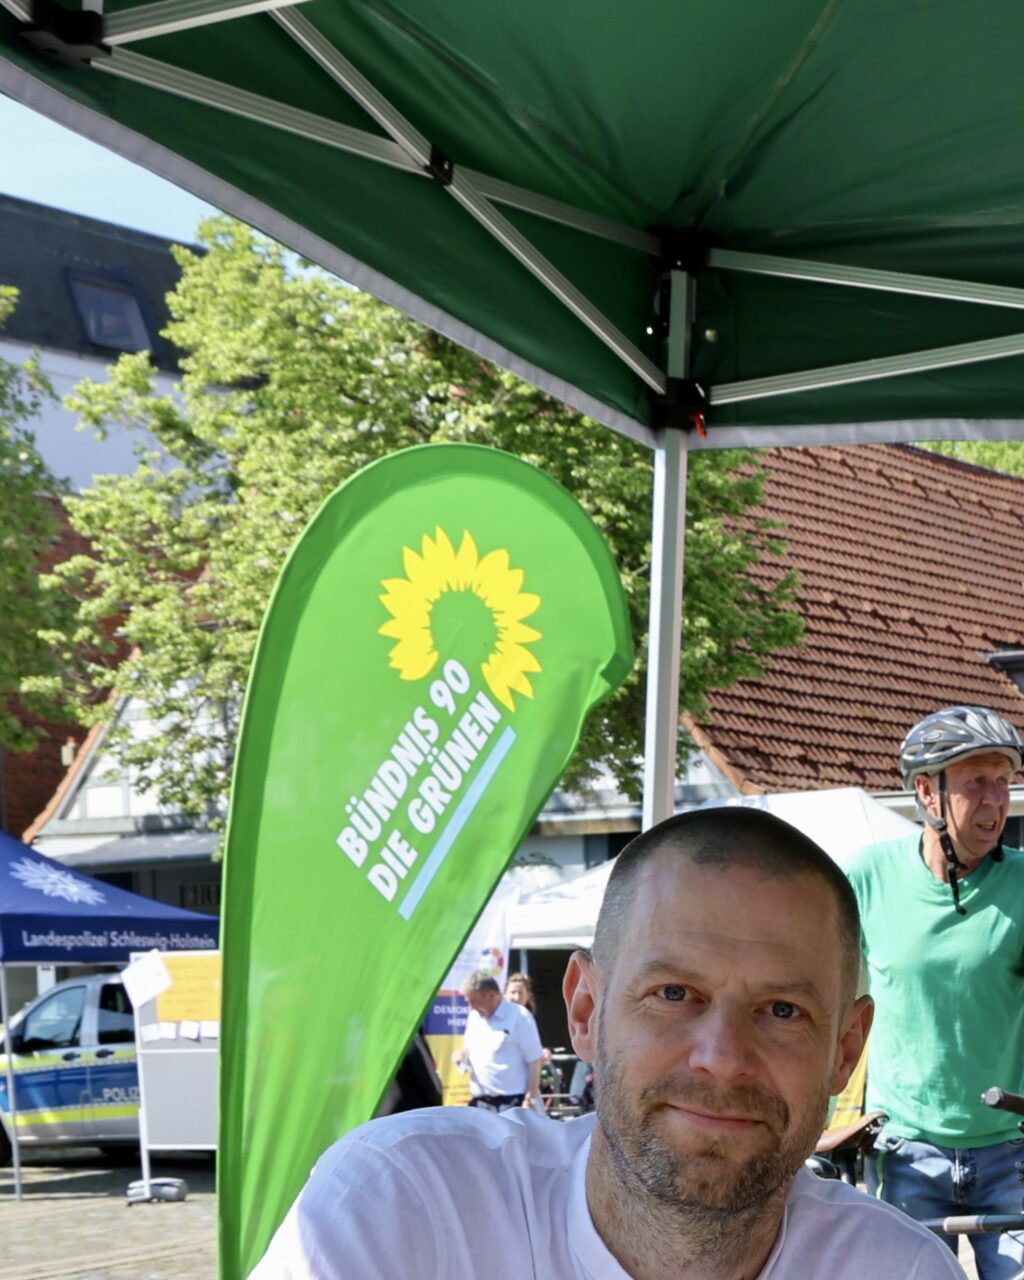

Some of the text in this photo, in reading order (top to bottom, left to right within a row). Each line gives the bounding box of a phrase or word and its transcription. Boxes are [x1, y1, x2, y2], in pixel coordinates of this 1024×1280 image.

[336, 659, 470, 868] BÜNDNIS 90
[367, 690, 502, 902] DIE GRÜNEN
[22, 930, 216, 950] Landespolizei Schleswig-Holstein
[433, 1005, 471, 1015] DEMOK
[103, 1087, 139, 1101] POLIZ
